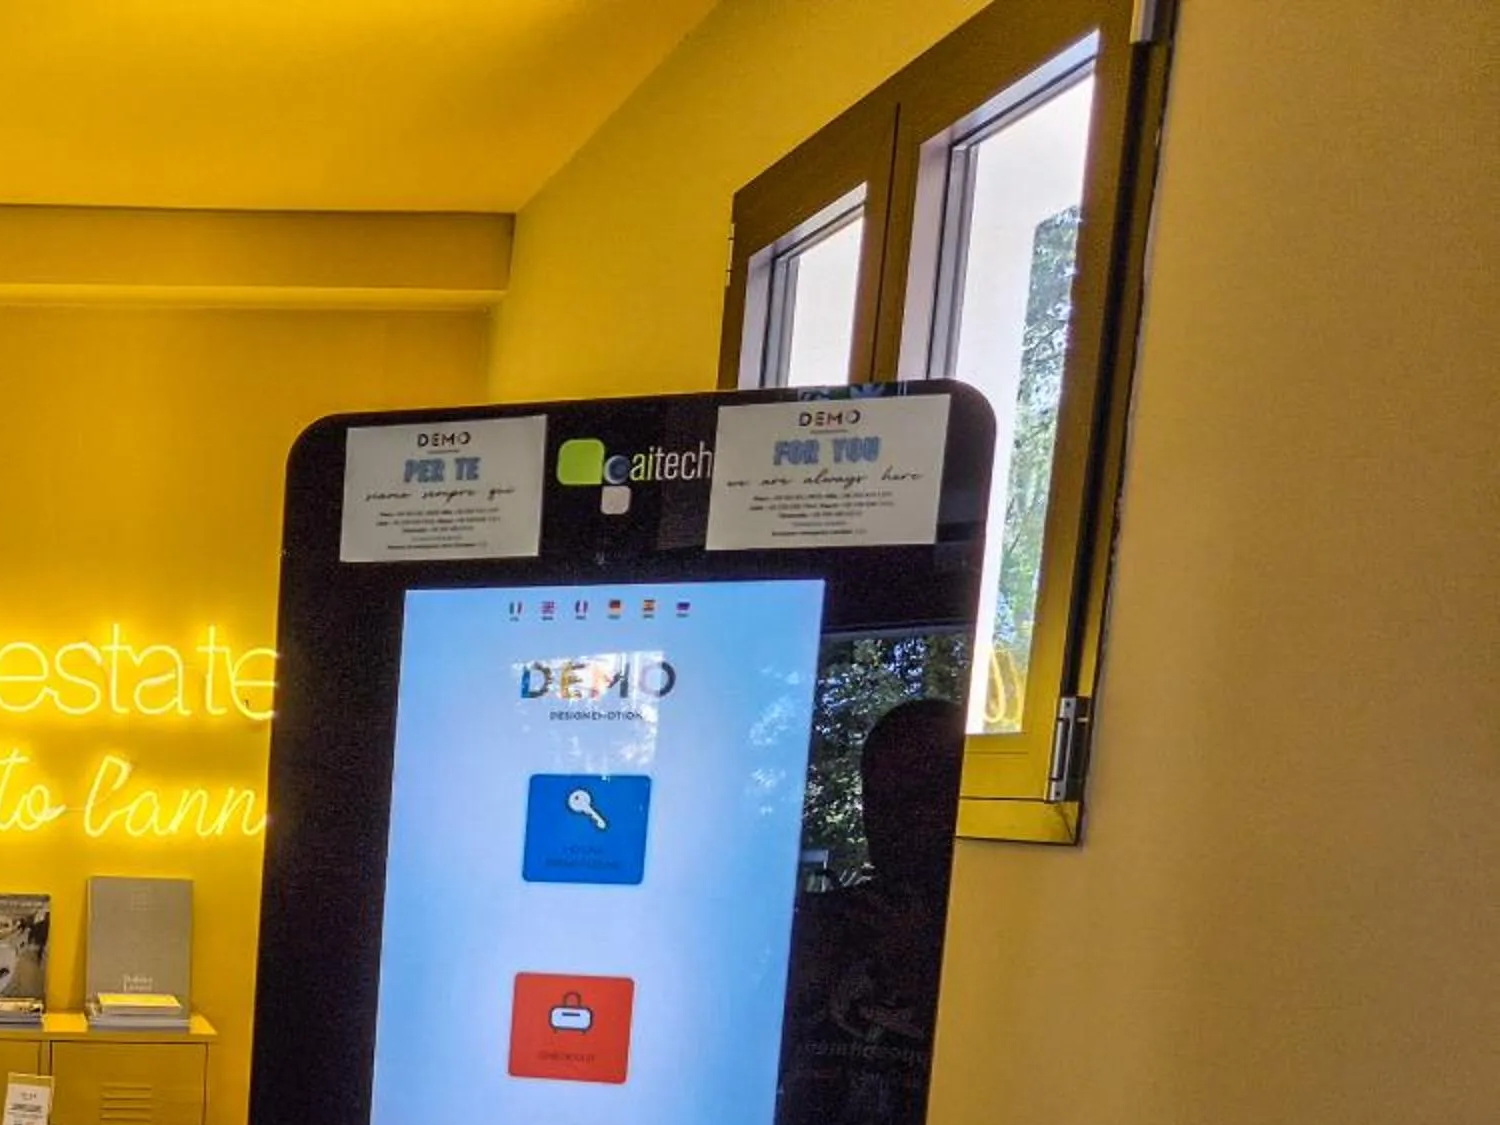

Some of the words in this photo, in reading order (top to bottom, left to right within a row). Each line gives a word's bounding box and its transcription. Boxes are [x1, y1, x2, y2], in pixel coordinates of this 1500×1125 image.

[799, 410, 861, 427] DEMO
[417, 432, 472, 448] DEMO
[773, 439, 820, 466] FOR
[832, 436, 881, 463] YOU
[404, 458, 445, 484] PER
[455, 457, 481, 481] TE
[803, 467, 869, 490] always
[880, 465, 925, 482] here
[84, 755, 268, 838] l'ann
